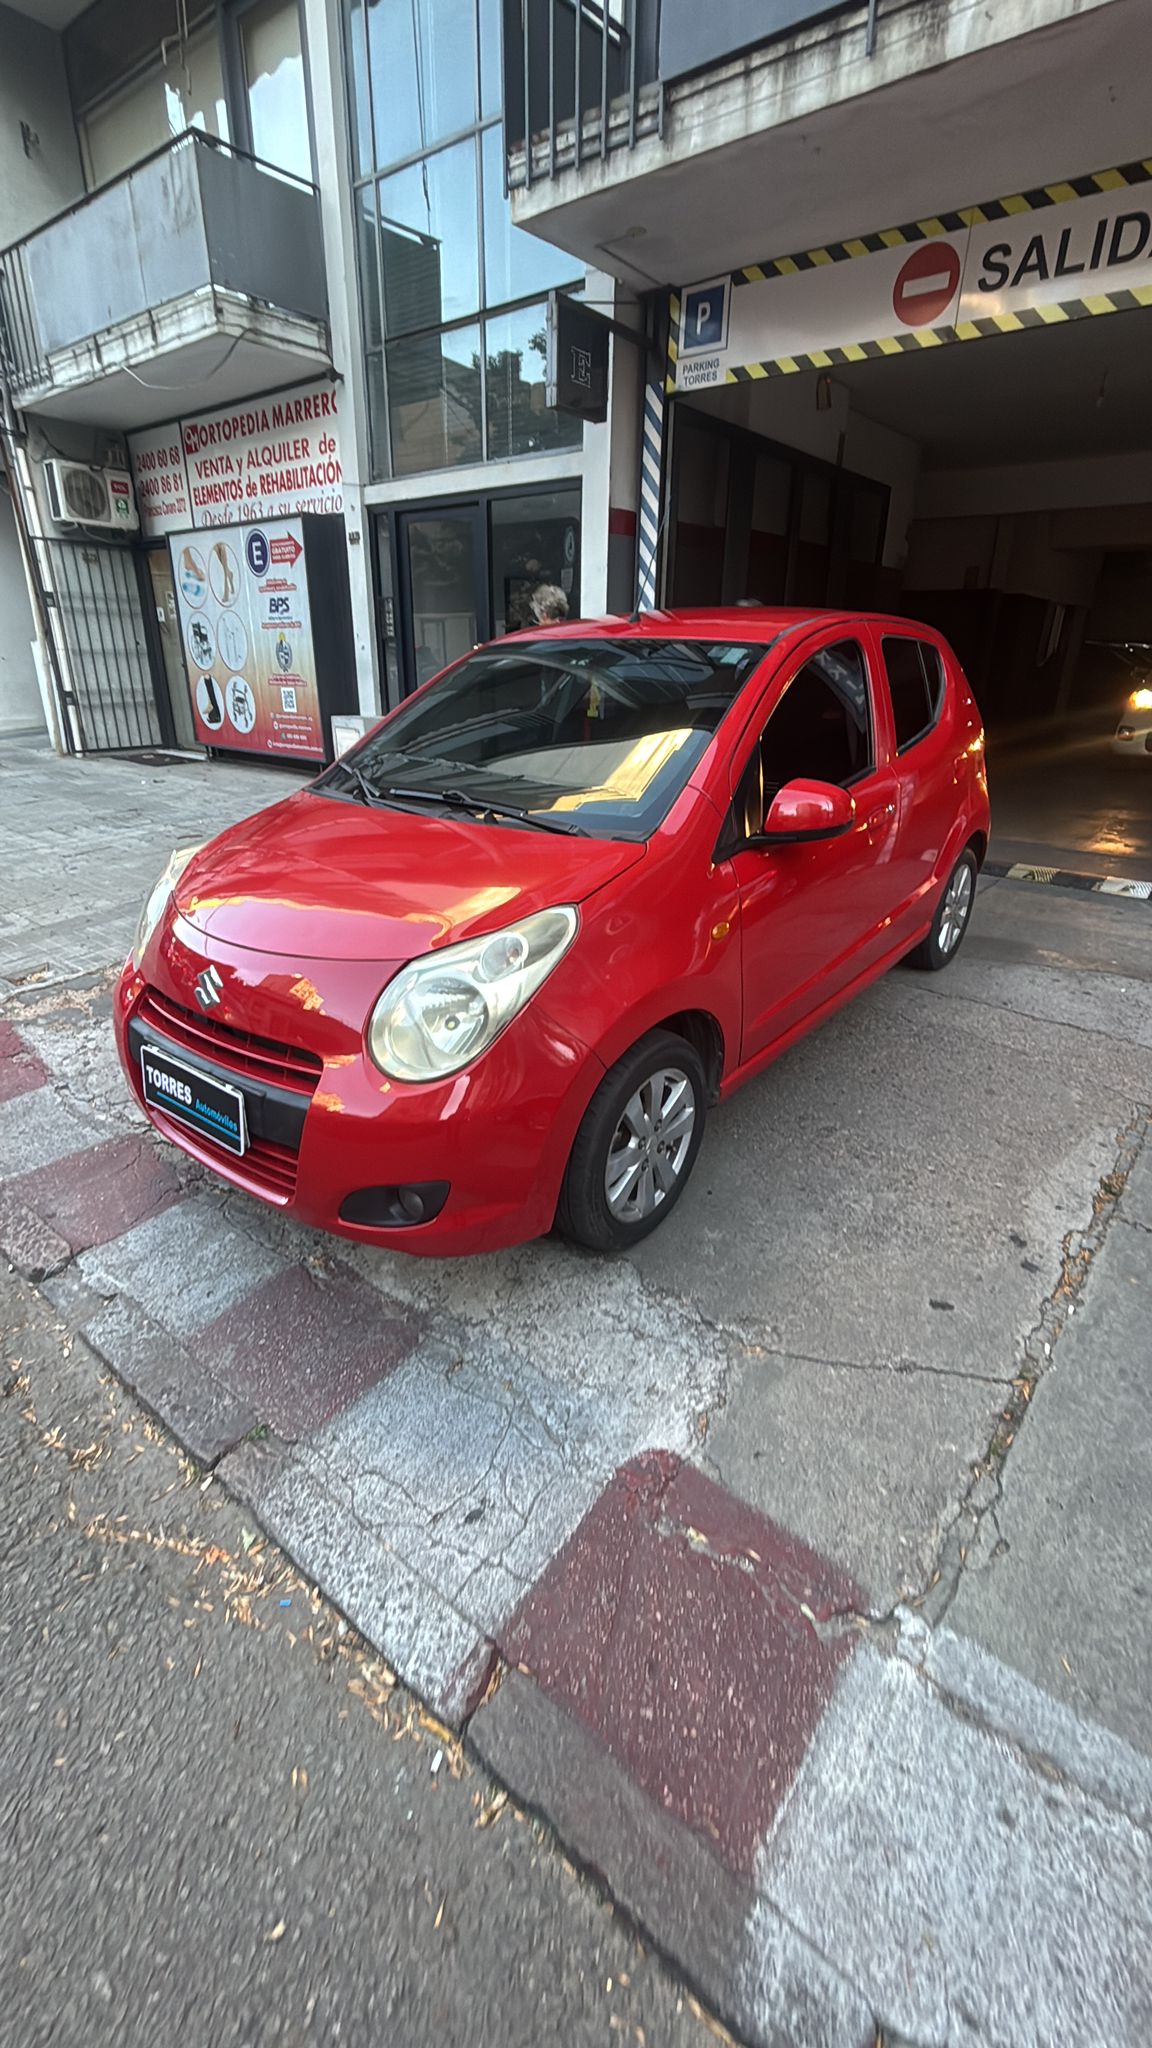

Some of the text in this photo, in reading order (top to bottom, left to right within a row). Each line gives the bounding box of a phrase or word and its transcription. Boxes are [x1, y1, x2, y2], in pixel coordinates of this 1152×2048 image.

[978, 211, 1152, 292] SALID
[696, 302, 711, 336] P
[682, 359, 720, 375] PARKING
[683, 371, 718, 387] TORRES
[200, 408, 270, 448] ORTOPEDIA
[136, 450, 156, 473] 2400
[194, 431, 336, 480] VENTA y ALQUILER de
[141, 476, 160, 497] 2400
[173, 472, 184, 492] 81
[193, 478, 243, 507] ELEMENTOS
[245, 475, 258, 498] de
[260, 454, 343, 496] REHABILITACIÓN
[201, 502, 233, 527] Desde
[237, 500, 263, 521] 1963
[278, 501, 291, 517] su
[296, 487, 343, 514] servicio
[252, 541, 264, 566] E
[269, 597, 291, 615] BPS
[146, 1064, 192, 1105] TORRES
